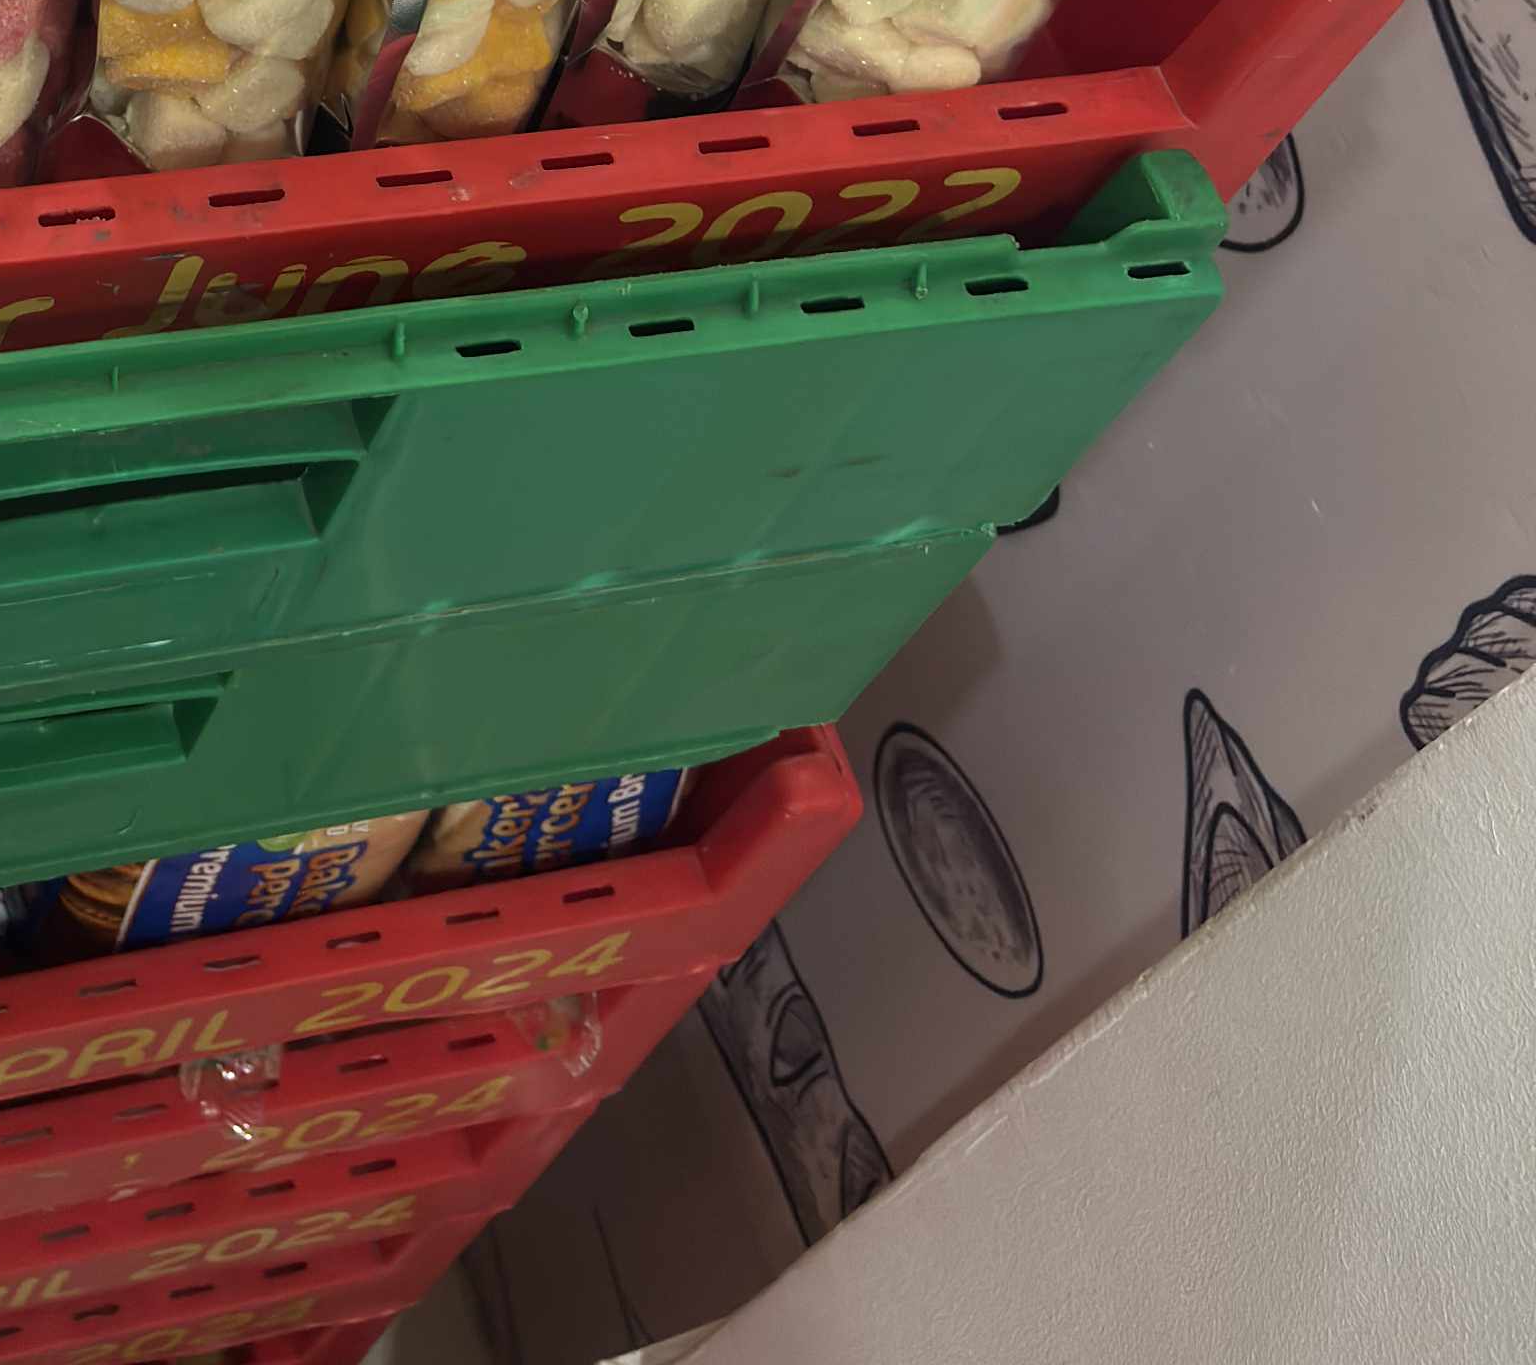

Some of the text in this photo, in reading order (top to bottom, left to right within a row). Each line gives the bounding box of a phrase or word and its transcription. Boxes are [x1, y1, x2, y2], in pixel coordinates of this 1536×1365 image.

[170, 845, 236, 933] remium
[292, 931, 630, 1034] 2024
[128, 1195, 420, 1281] 2024
